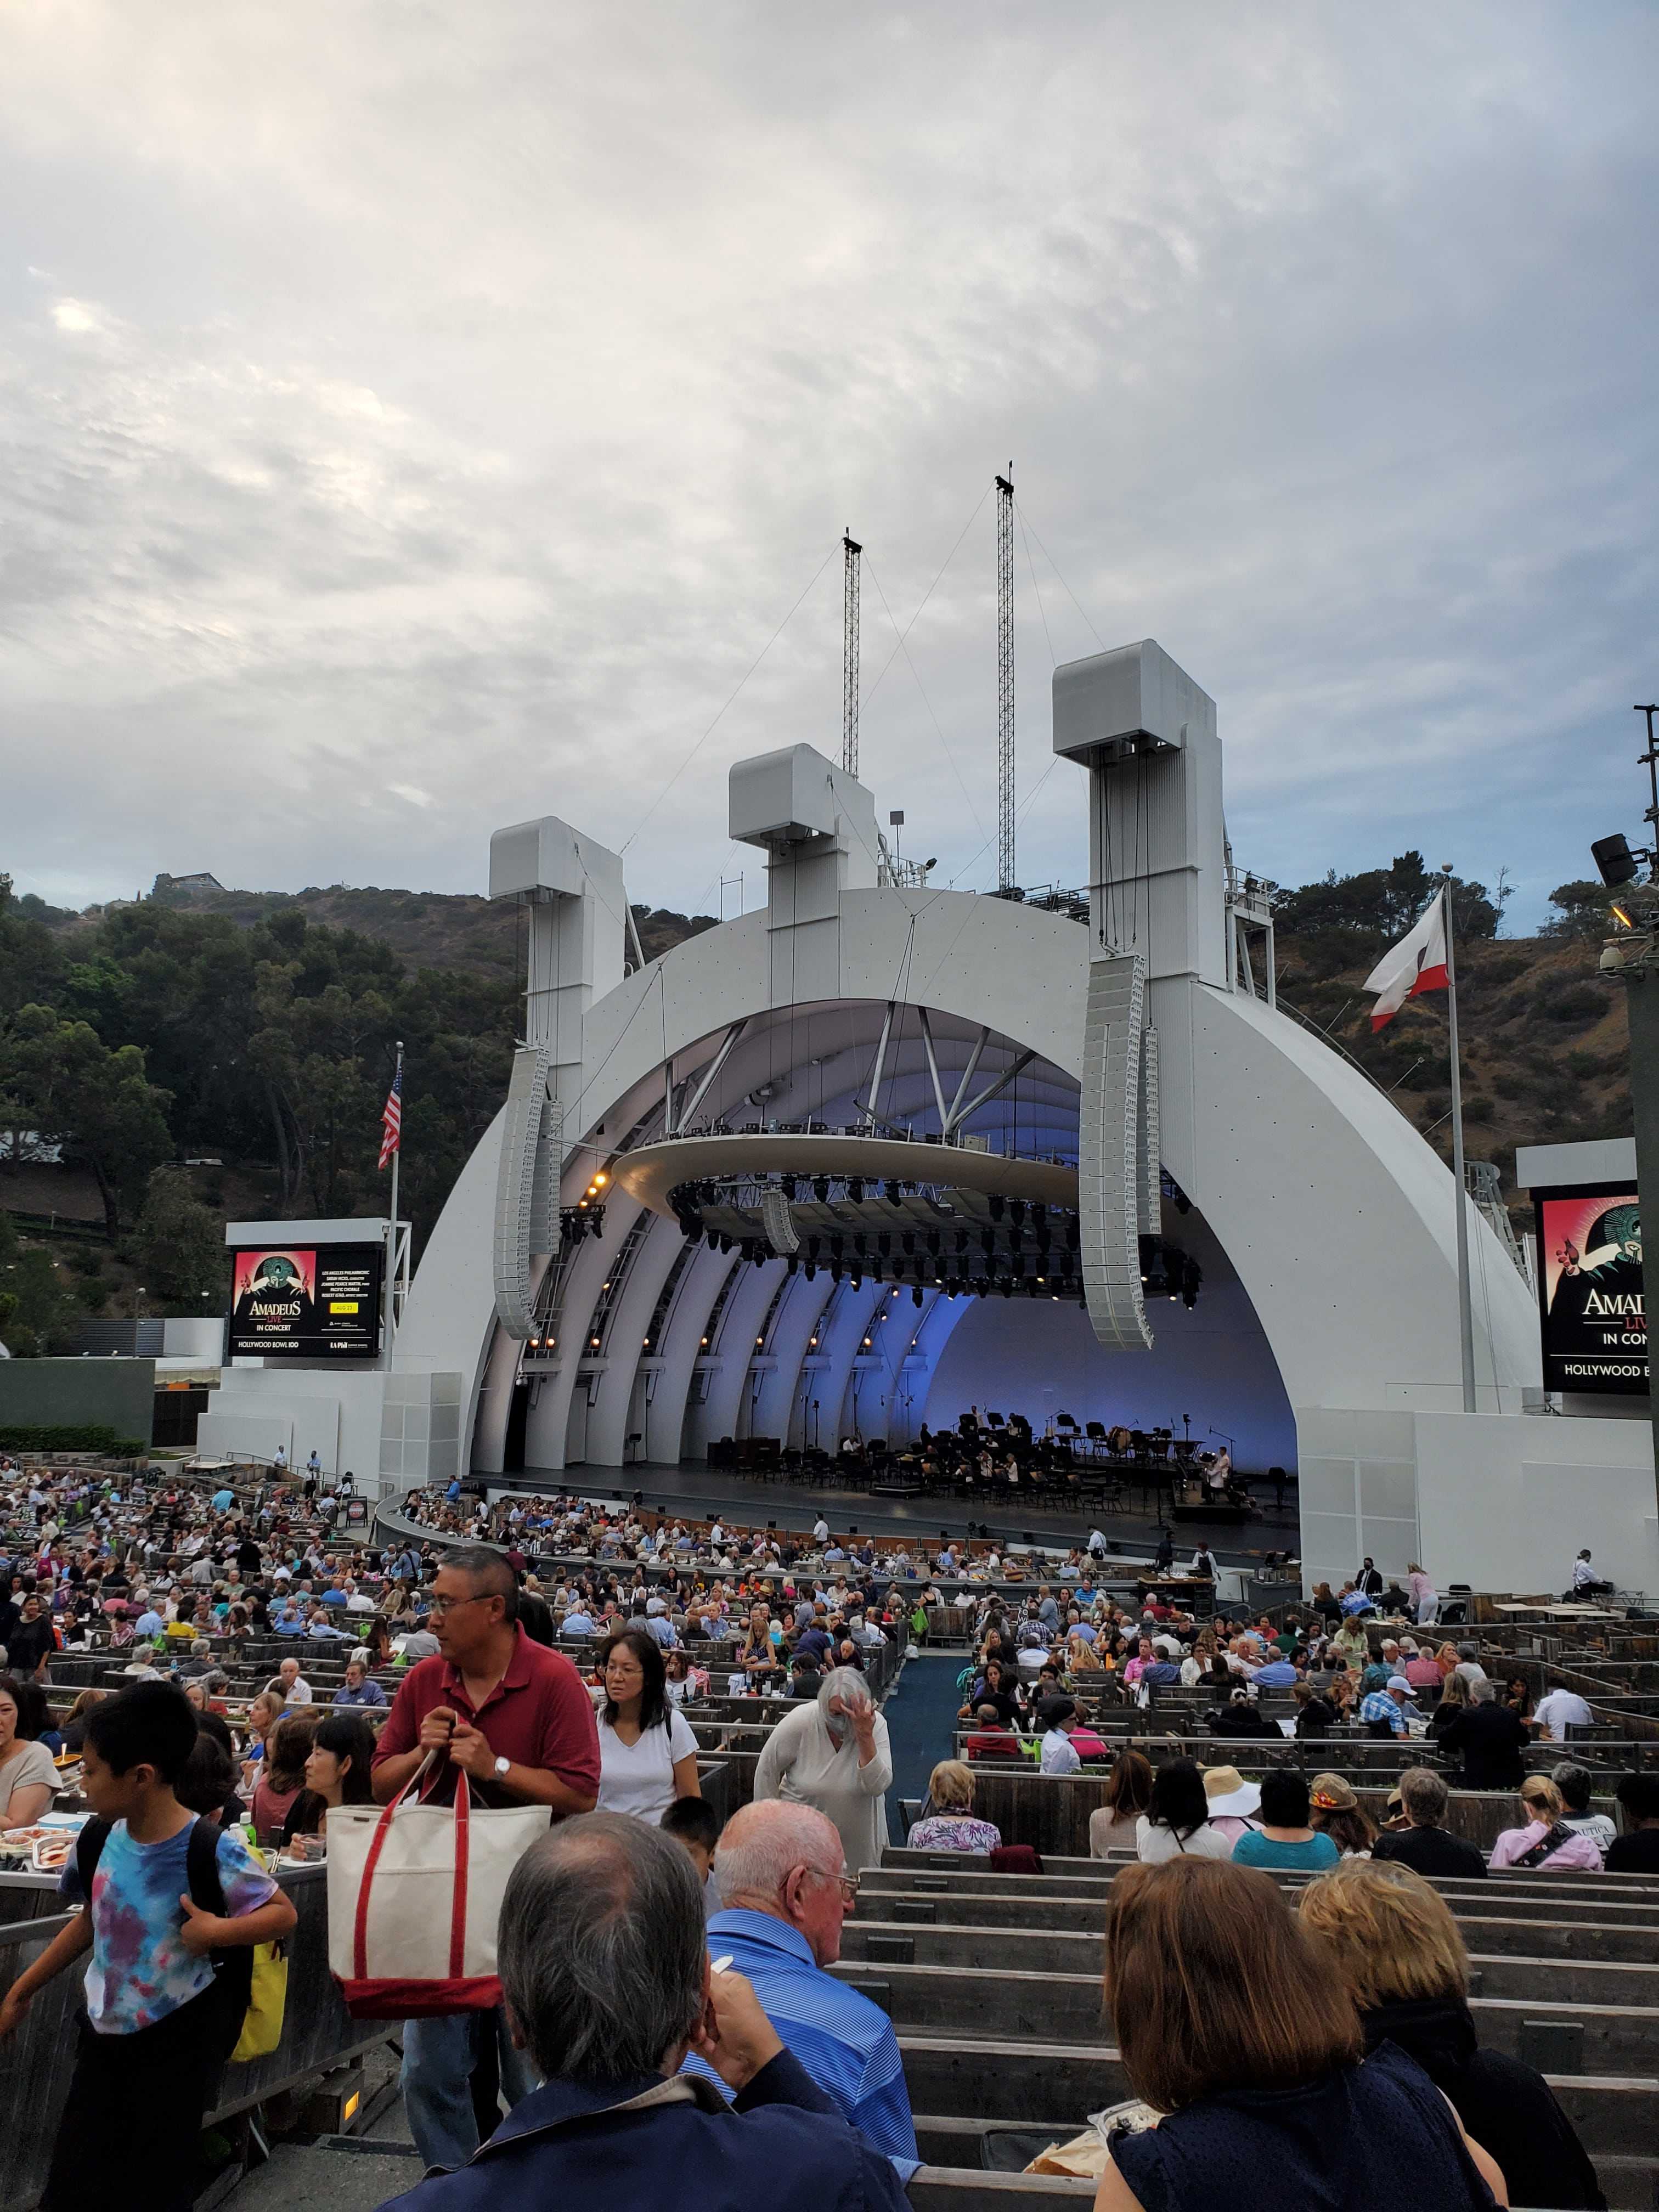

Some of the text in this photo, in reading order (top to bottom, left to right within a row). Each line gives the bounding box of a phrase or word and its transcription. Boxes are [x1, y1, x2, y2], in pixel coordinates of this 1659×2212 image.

[249, 1300, 301, 1316] AMADEUS
[1625, 1317, 1647, 1329] LIV
[1603, 1333, 1647, 1345] IN CON
[1565, 1364, 1641, 1376] HOLLYWOOD
